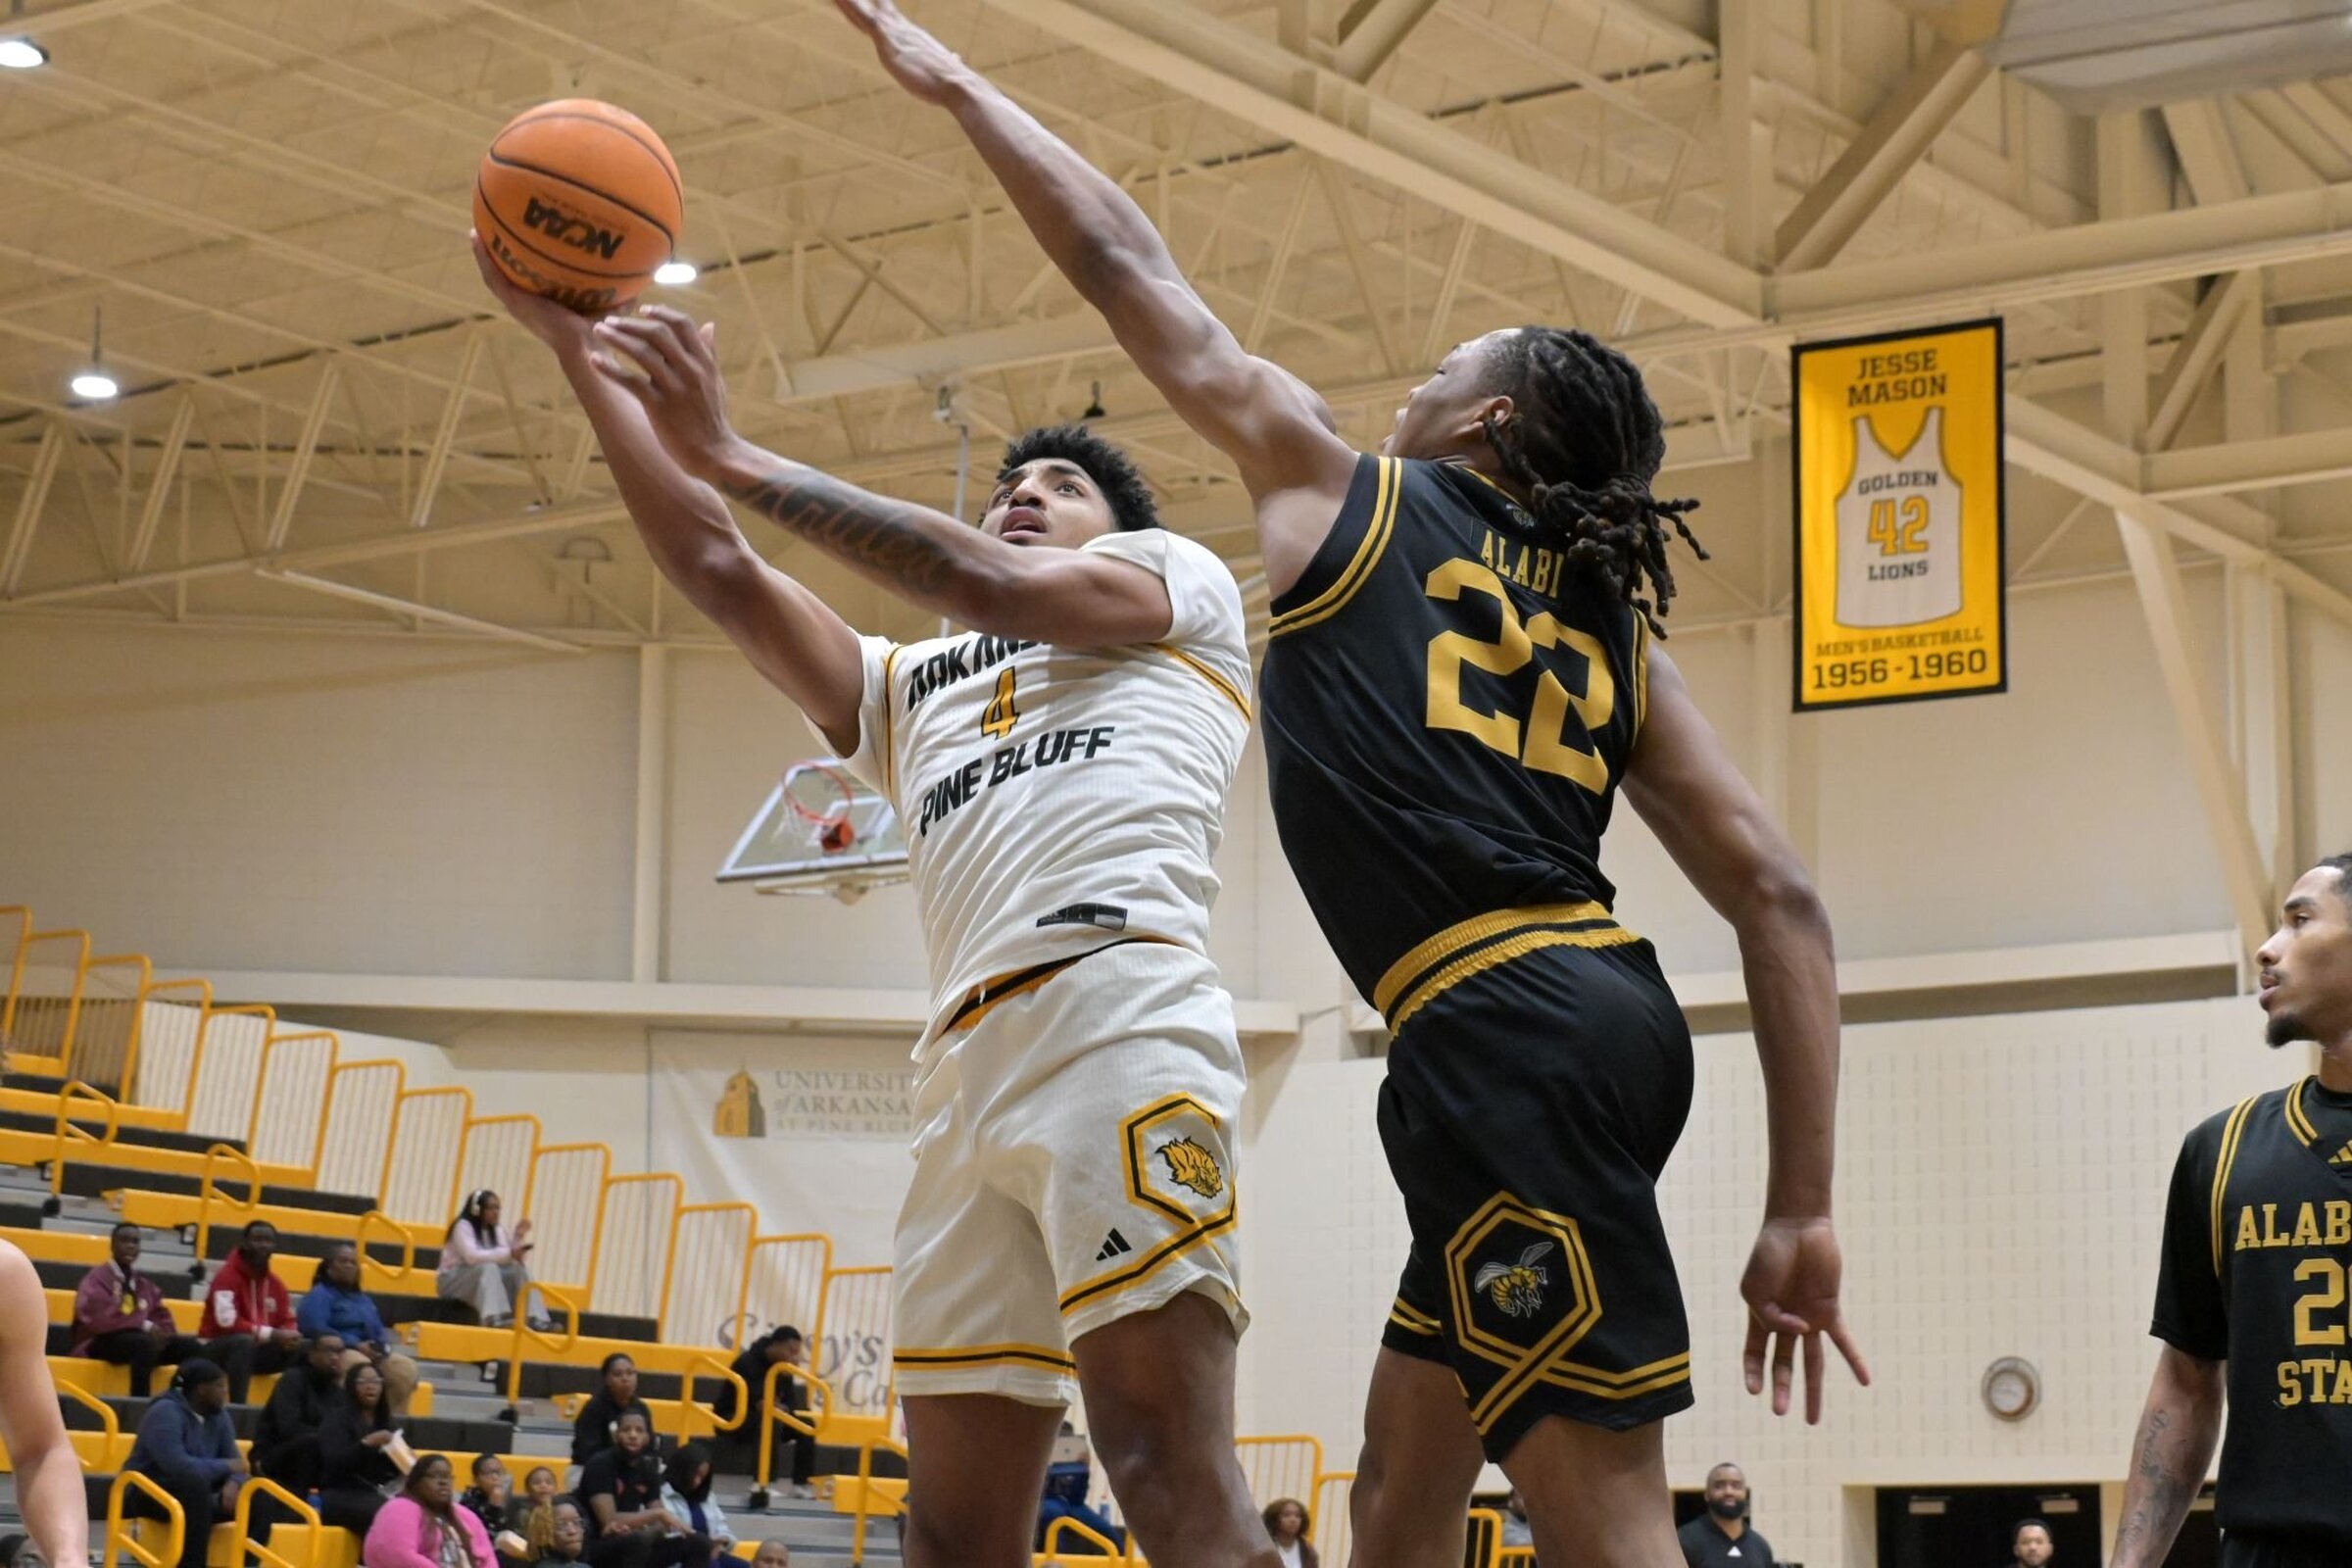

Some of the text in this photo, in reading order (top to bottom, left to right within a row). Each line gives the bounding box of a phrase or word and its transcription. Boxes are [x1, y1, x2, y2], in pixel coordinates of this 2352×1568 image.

[522, 196, 625, 261] NCAA
[1858, 349, 1937, 380] JESSE
[1847, 374, 1948, 408] MASON
[1858, 470, 1938, 496] GOLDEN
[1867, 495, 1931, 557] 42
[1480, 529, 1565, 600] ALABI
[1868, 560, 1929, 581] LIONS
[1816, 627, 1984, 657] MEN'S BASKETBALL
[907, 634, 1049, 712] ARKAN
[1425, 557, 1615, 797] 22
[1813, 658, 1888, 690] 1956
[1908, 649, 1986, 680] 1960
[981, 665, 1021, 741] 4
[919, 726, 1115, 838] PINE BLUFF
[775, 1069, 910, 1093] UNIVERSIT
[795, 1095, 911, 1116] ARKANSA
[2234, 1200, 2352, 1250] ALAB
[2293, 1258, 2352, 1347] 2
[2277, 1359, 2352, 1407] STA
